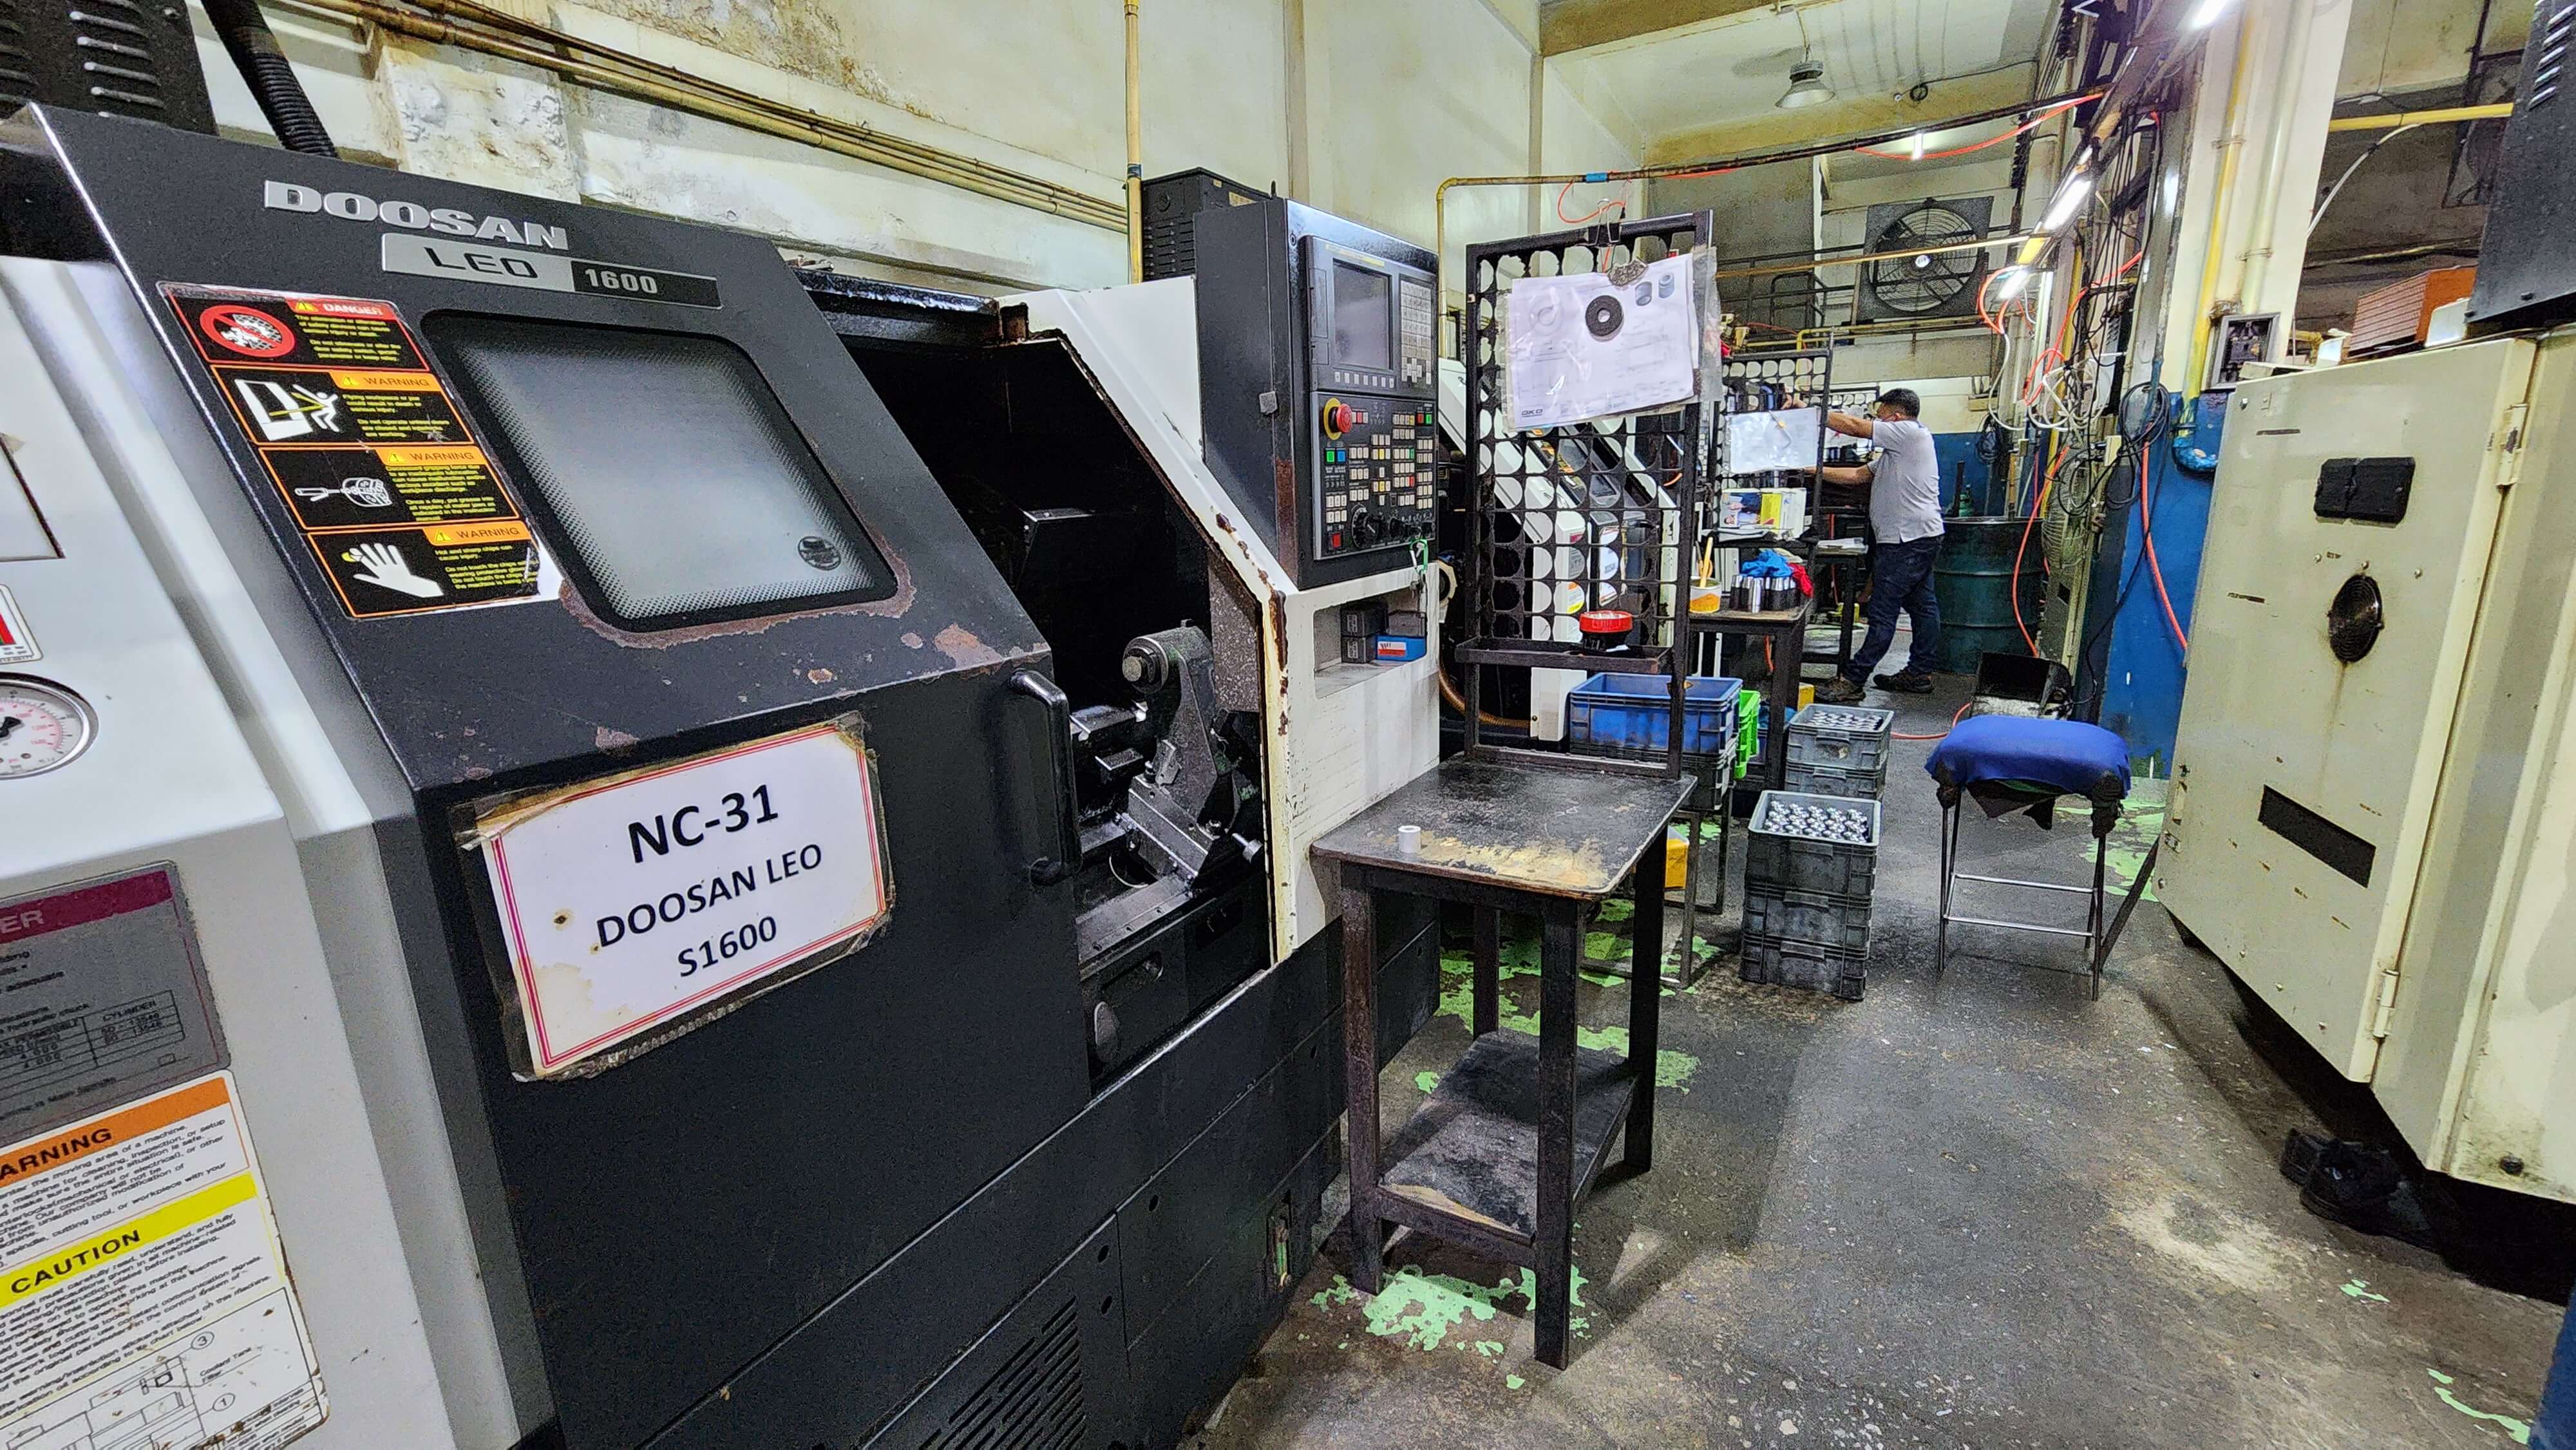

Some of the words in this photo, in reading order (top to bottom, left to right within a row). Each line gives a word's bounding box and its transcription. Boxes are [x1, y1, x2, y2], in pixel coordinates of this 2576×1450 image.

[264, 179, 569, 250] DOOSAN
[424, 246, 539, 279] LEO
[583, 268, 659, 296] 1600
[322, 303, 384, 315] DANGER
[363, 377, 430, 387] WARNING
[410, 451, 475, 461] WARNING
[456, 527, 520, 538] WARNING
[628, 784, 779, 864] NC-31
[596, 865, 756, 948] DOOSAN
[766, 843, 823, 884] LEO
[0, 910, 45, 935] ER
[677, 916, 778, 978] S1600
[0, 1128, 112, 1180] ARNING
[12, 1181, 60, 1205] machine
[62, 1174, 77, 1185] for
[199, 1118, 226, 1133] setup
[12, 1196, 43, 1212] make
[46, 1185, 70, 1199] sure
[73, 1177, 90, 1189] the
[93, 1164, 124, 1181] entire
[126, 1147, 168, 1167] situation
[182, 1133, 204, 1146] safe.
[31, 1176, 48, 1187] the
[52, 1160, 91, 1180] moving
[95, 1150, 118, 1163] area
[144, 1124, 187, 1144] machine.
[0, 1176, 115, 1228] nterlocks(mechanical
[11, 1229, 140, 1294] CAUTION
[197, 1335, 208, 1346] 3
[220, 1398, 227, 1406] 1
